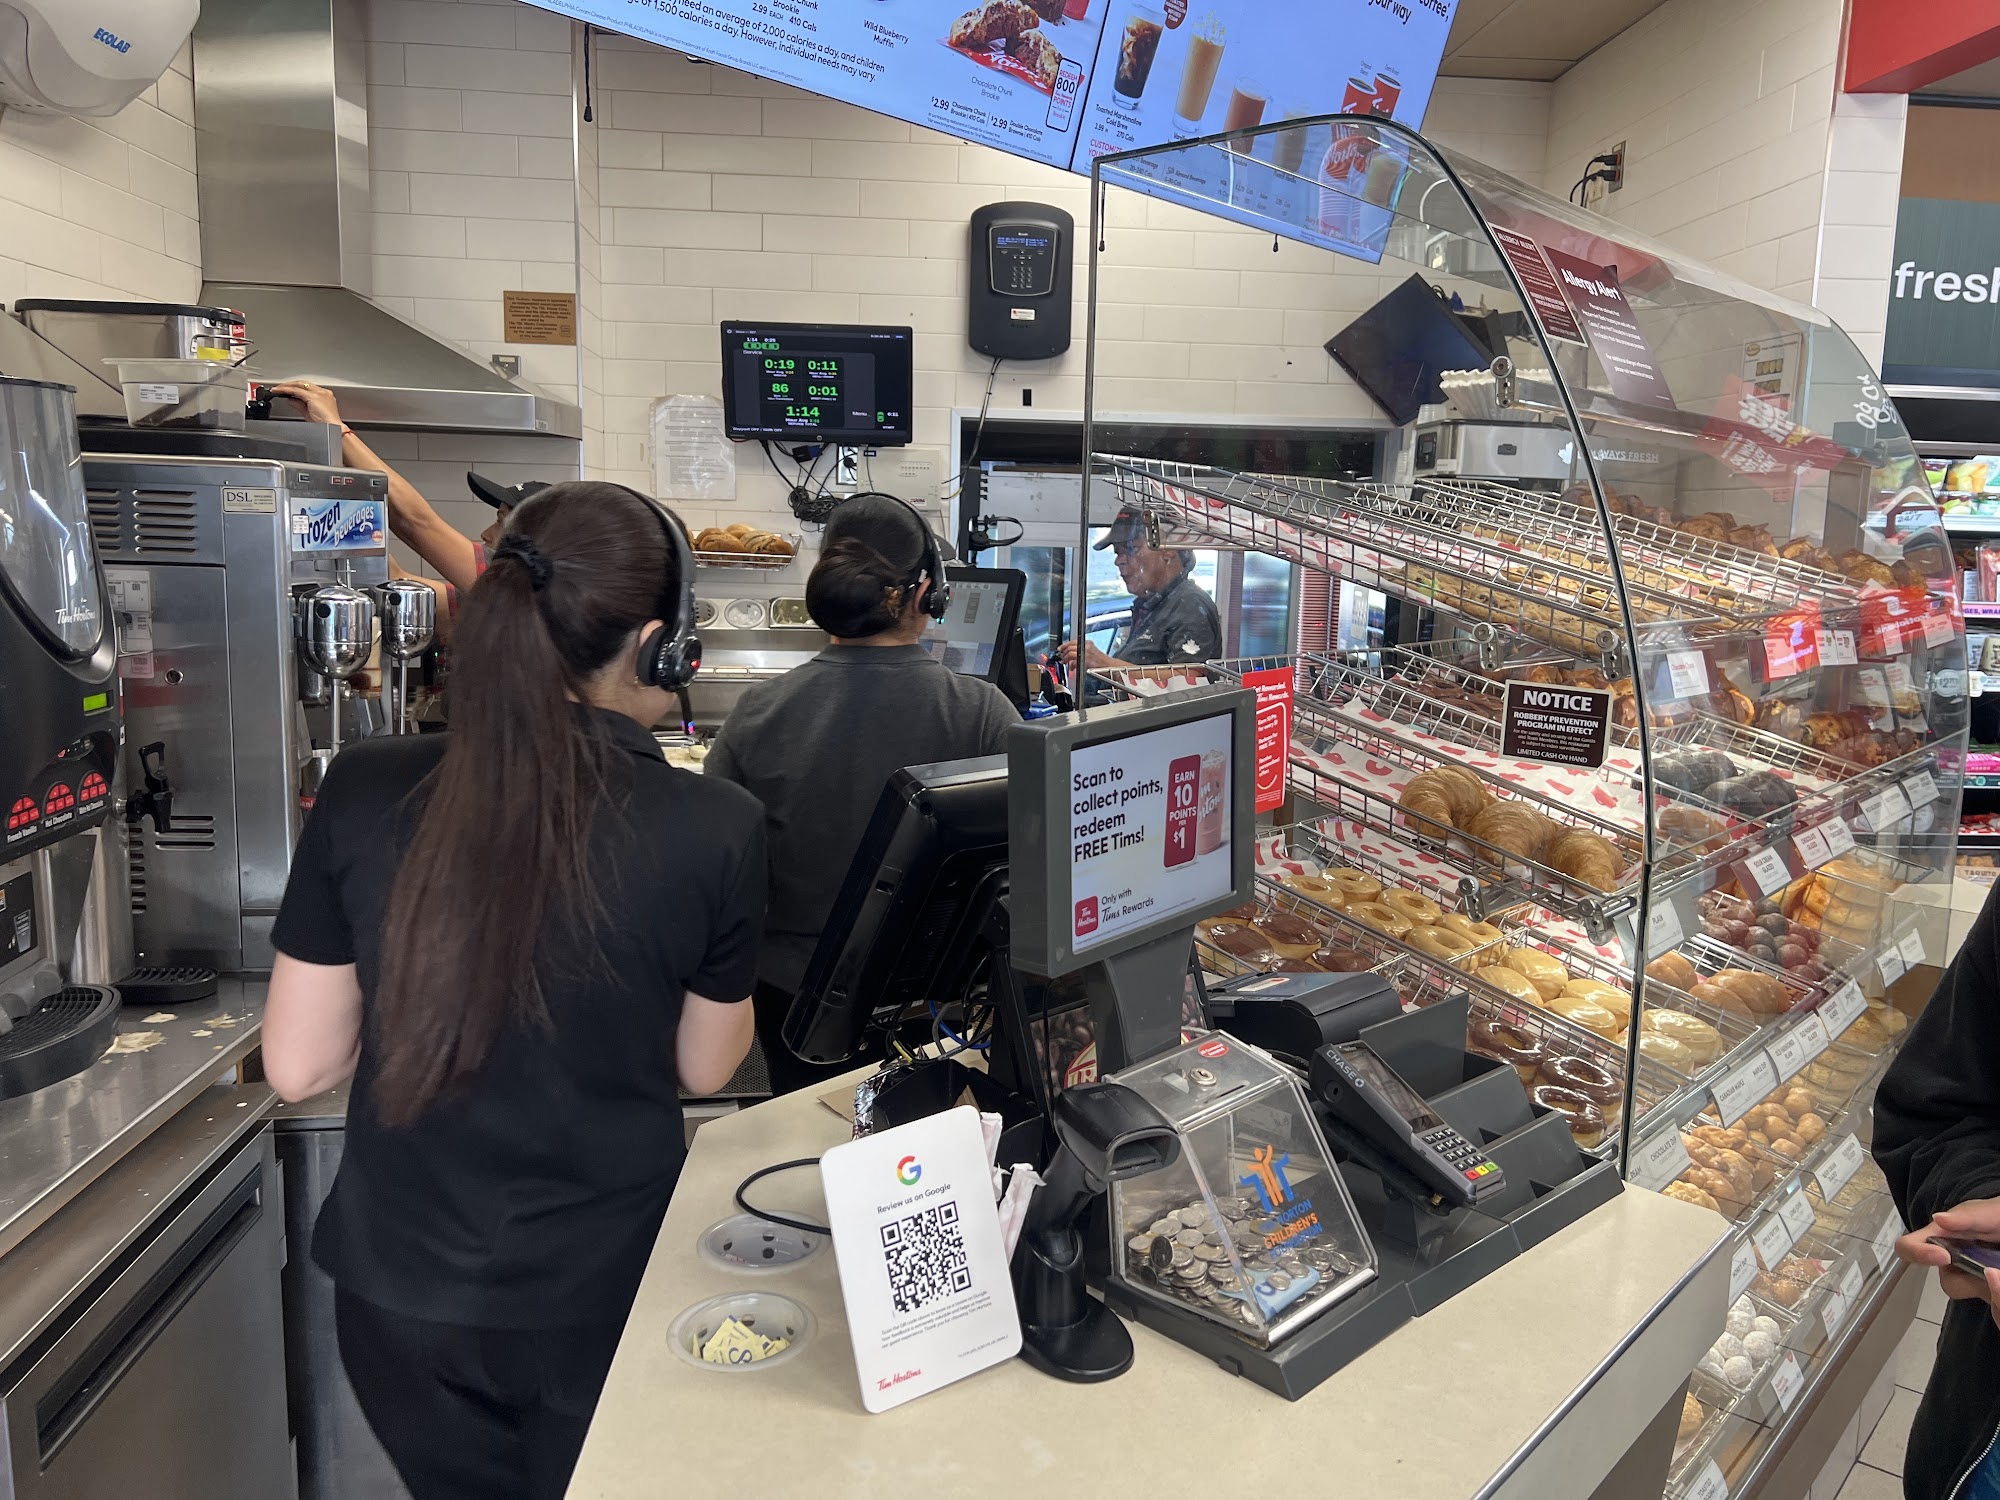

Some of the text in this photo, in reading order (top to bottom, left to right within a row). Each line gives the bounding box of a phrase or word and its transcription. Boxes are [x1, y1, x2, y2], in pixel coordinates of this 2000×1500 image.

[752, 3, 817, 32] 2.99 EACH 410 Cals
[773, 0, 799, 15] Brookie
[1391, 2, 1412, 25] way
[93, 28, 131, 54] ECOLAB
[653, 0, 876, 82] 1,500 calories a day. However, individual needs may vary.
[702, 6, 714, 16] an
[715, 10, 751, 29] average
[752, 20, 762, 31] of
[762, 23, 786, 39] 2,000
[786, 33, 817, 52] calories
[817, 44, 823, 53] a
[824, 43, 840, 59] day,
[840, 49, 856, 64] and
[856, 53, 885, 73] children
[864, 20, 909, 44] Wild Blueberry
[873, 35, 894, 49] Muffin
[971, 76, 1013, 97] Chocolate Chunk
[981, 90, 1001, 101] Brookie
[1057, 77, 1075, 94] 800
[932, 96, 949, 111] $2.99
[991, 115, 1008, 130] $2.99
[1096, 103, 1142, 127] Toasted Marshmallow
[1106, 117, 1128, 131] Cold Brew
[1560, 267, 1599, 297] Allergy
[1594, 279, 1622, 301] Alert
[764, 359, 838, 371] 0:19 0:11
[772, 383, 839, 397] 86 0:01
[786, 406, 820, 418] 1:14
[1628, 451, 1659, 463] FRESH
[227, 492, 253, 502] DSL
[334, 506, 374, 547] beverages
[55, 609, 72, 624] Tim
[1522, 690, 1593, 712] NOTICE
[1513, 711, 1599, 728] ROBBERY PREVENTION
[1517, 720, 1594, 736] PROGRAM IN EFFECT
[1517, 748, 1588, 763] LIMITED CASH ON HAND
[1073, 766, 1124, 791] Scan to
[1174, 770, 1195, 783] EARN
[1073, 779, 1164, 815] collect points,
[1174, 784, 1192, 807] 10
[1169, 807, 1197, 821] POINTS
[1073, 812, 1126, 839] redeem
[1074, 825, 1145, 863] FREE Tims!
[1173, 827, 1185, 849] $1
[1964, 869, 1997, 877] TAQUITO
[1101, 888, 1132, 906] Only with
[1101, 898, 1154, 923] Tims Rewards
[1652, 913, 1664, 926] PLAIN
[1326, 1049, 1357, 1080] CHASE
[1719, 1078, 1746, 1103] CANADIAN MAPLE
[1650, 1135, 1677, 1162] CHOCOLATE DIP
[877, 1199, 903, 1214] Review
[914, 1193, 924, 1201] on
[924, 1183, 951, 1198] Google
[1264, 1213, 1318, 1250] CHILDREN'S
[1732, 1263, 1743, 1278] HONEY
[951, 1311, 969, 1321] choosing
[891, 1328, 911, 1338] feedback
[914, 1319, 935, 1329] extremely
[877, 1368, 922, 1392] Tim Hortons
[1697, 1477, 1712, 1498] TOASTED
